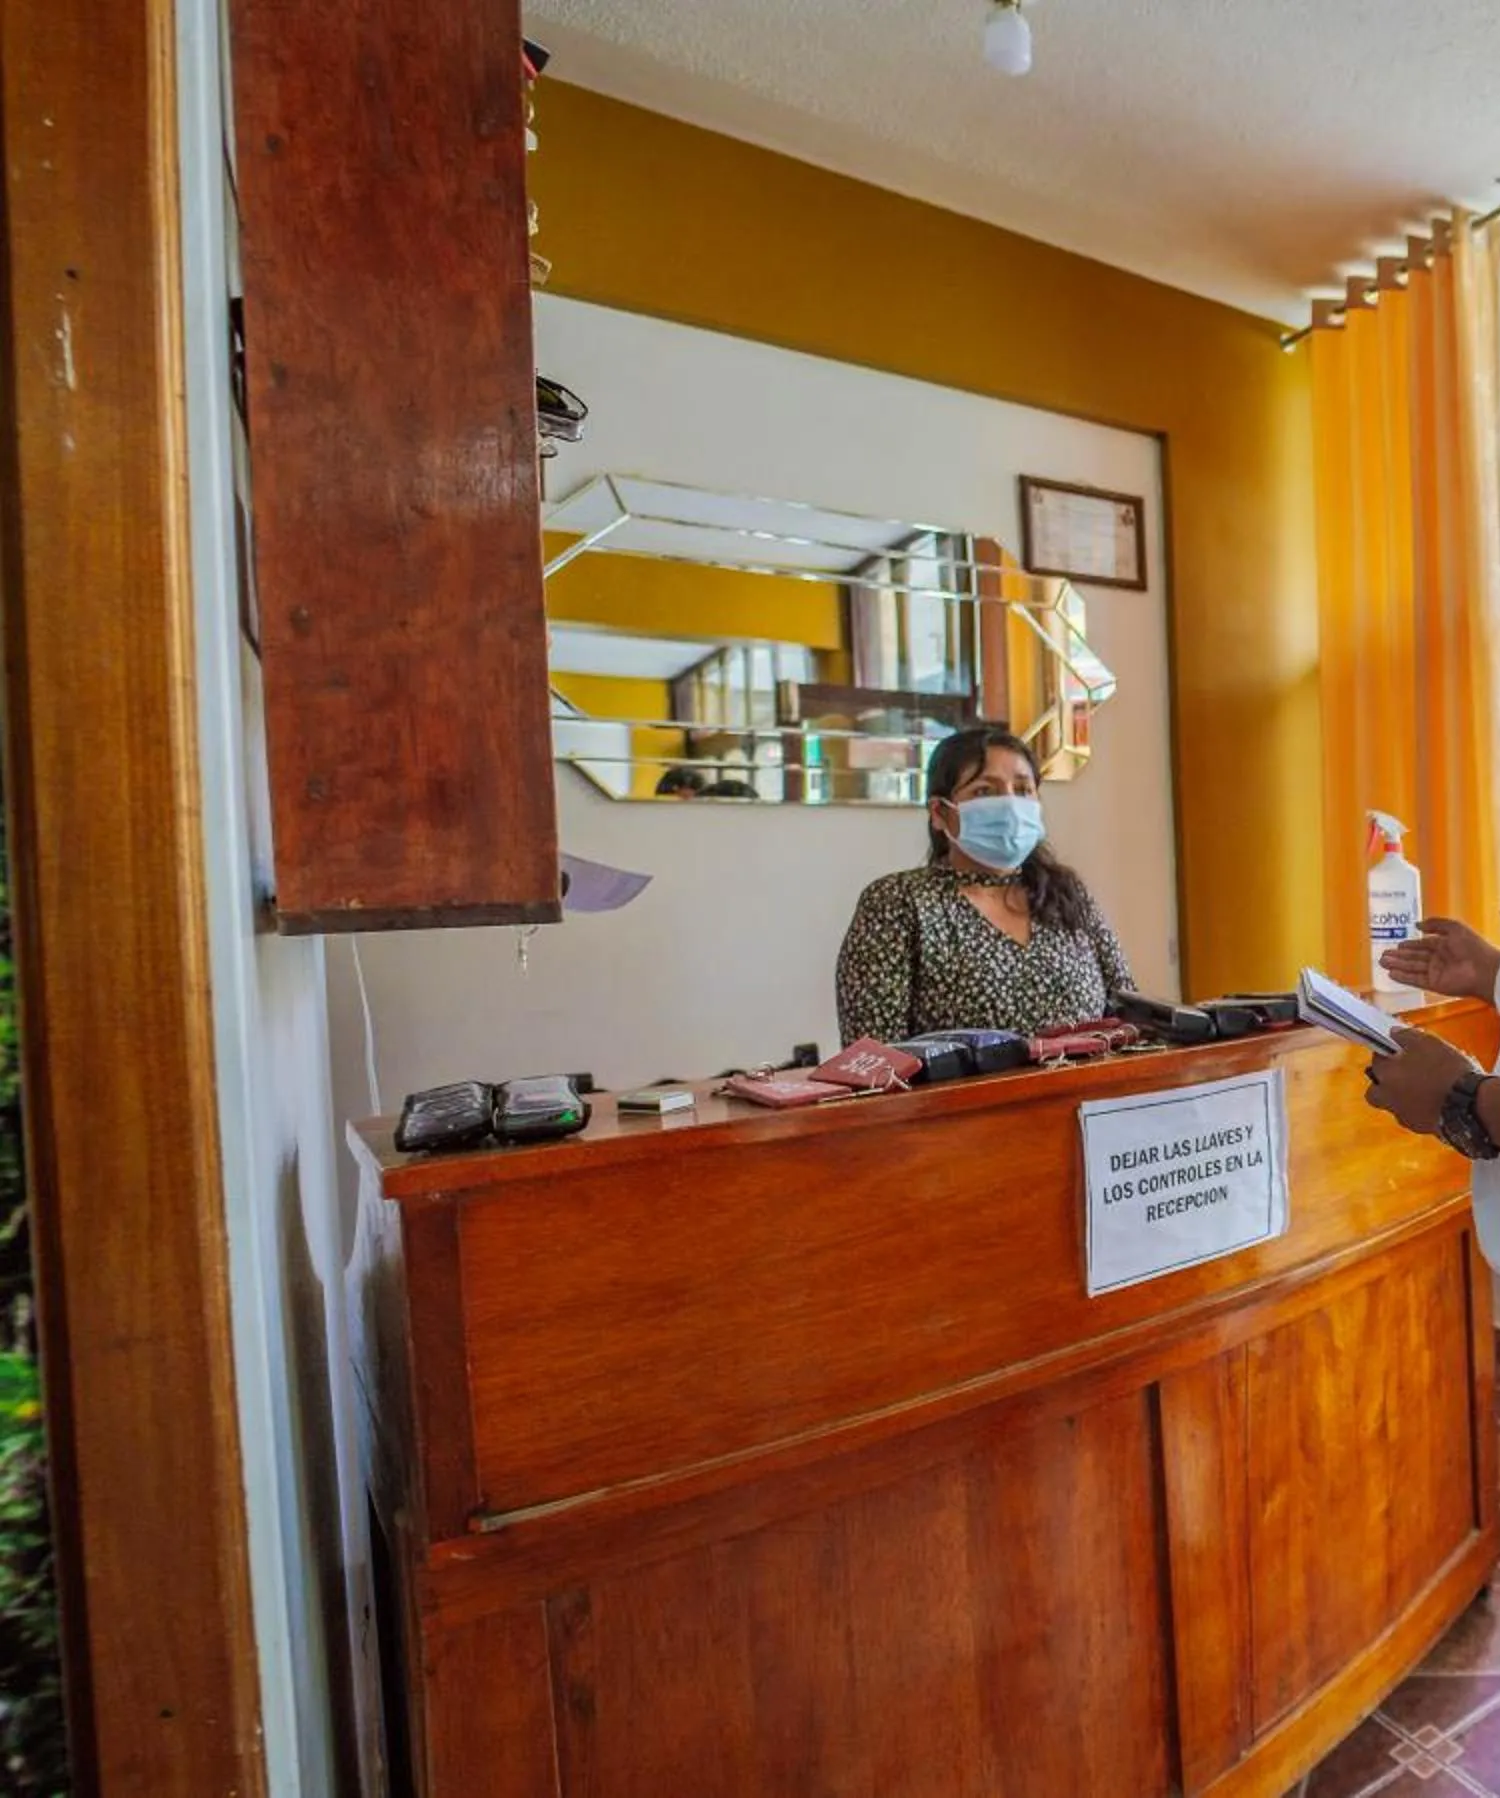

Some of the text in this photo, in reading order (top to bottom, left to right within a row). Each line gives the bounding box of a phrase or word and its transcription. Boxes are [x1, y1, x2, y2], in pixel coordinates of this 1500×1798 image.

[1109, 1124, 1254, 1173] DEJAR LAS LLAVES Y
[1103, 1150, 1263, 1205] LOS CONTROLES EN LA
[1146, 1185, 1229, 1223] RECEPCION
